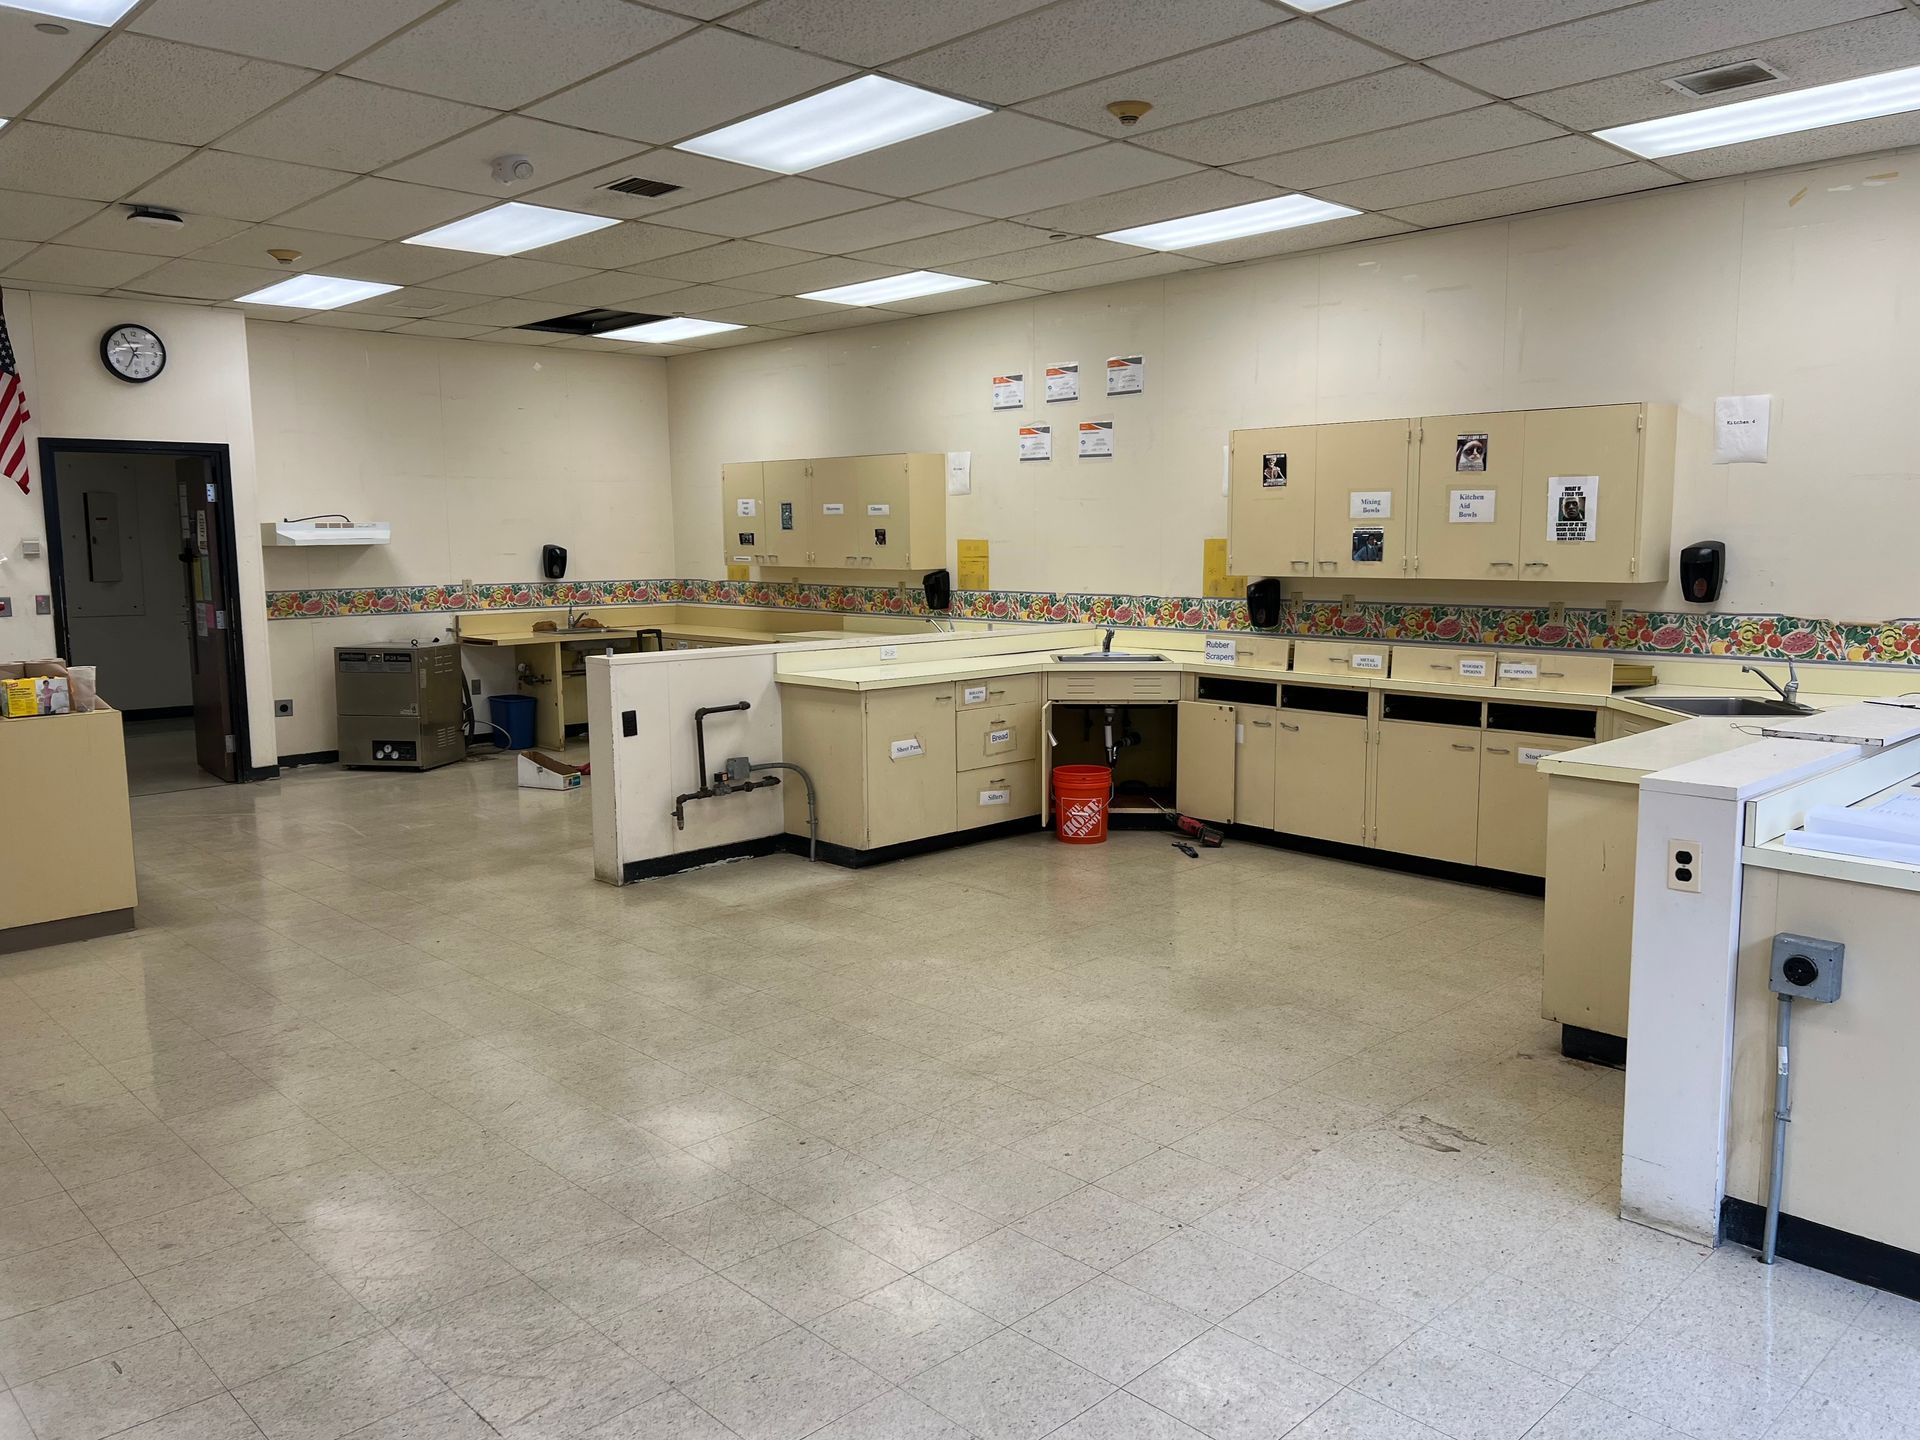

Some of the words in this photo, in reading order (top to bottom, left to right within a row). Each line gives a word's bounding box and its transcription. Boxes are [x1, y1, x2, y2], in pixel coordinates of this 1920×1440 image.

[1206, 640, 1230, 649] Rubber
[1206, 653, 1234, 661] Scrapers
[992, 733, 1008, 742] Bread
[1066, 803, 1082, 817] THE
[1063, 799, 1102, 836] HOME
[1077, 813, 1101, 836] DEPOT
